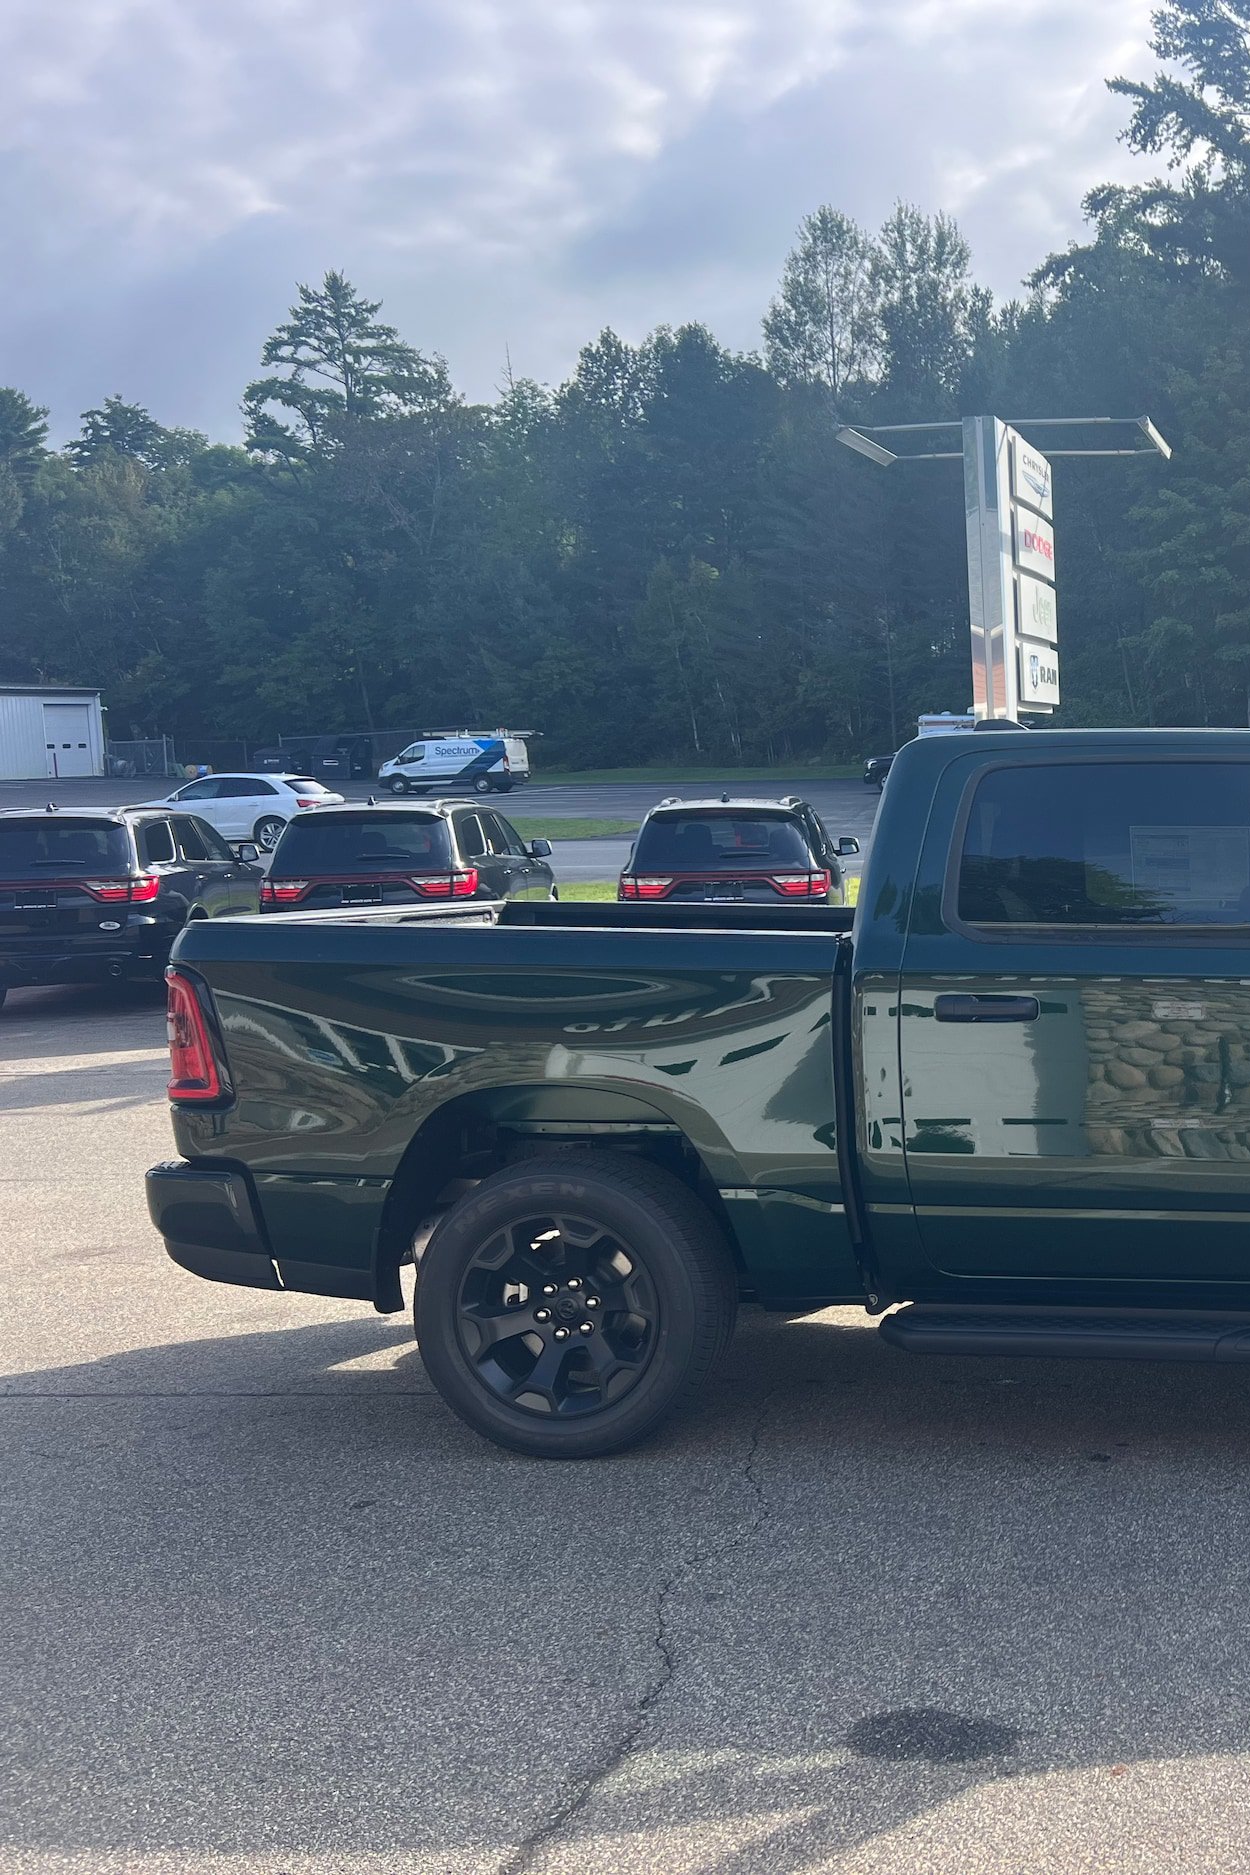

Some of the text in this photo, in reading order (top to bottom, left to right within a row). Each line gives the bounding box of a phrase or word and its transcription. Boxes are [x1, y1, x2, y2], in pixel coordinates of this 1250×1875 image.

[1024, 529, 1052, 561] DODGE
[1040, 665, 1057, 686] RAM
[435, 746, 478, 757] Spectrum
